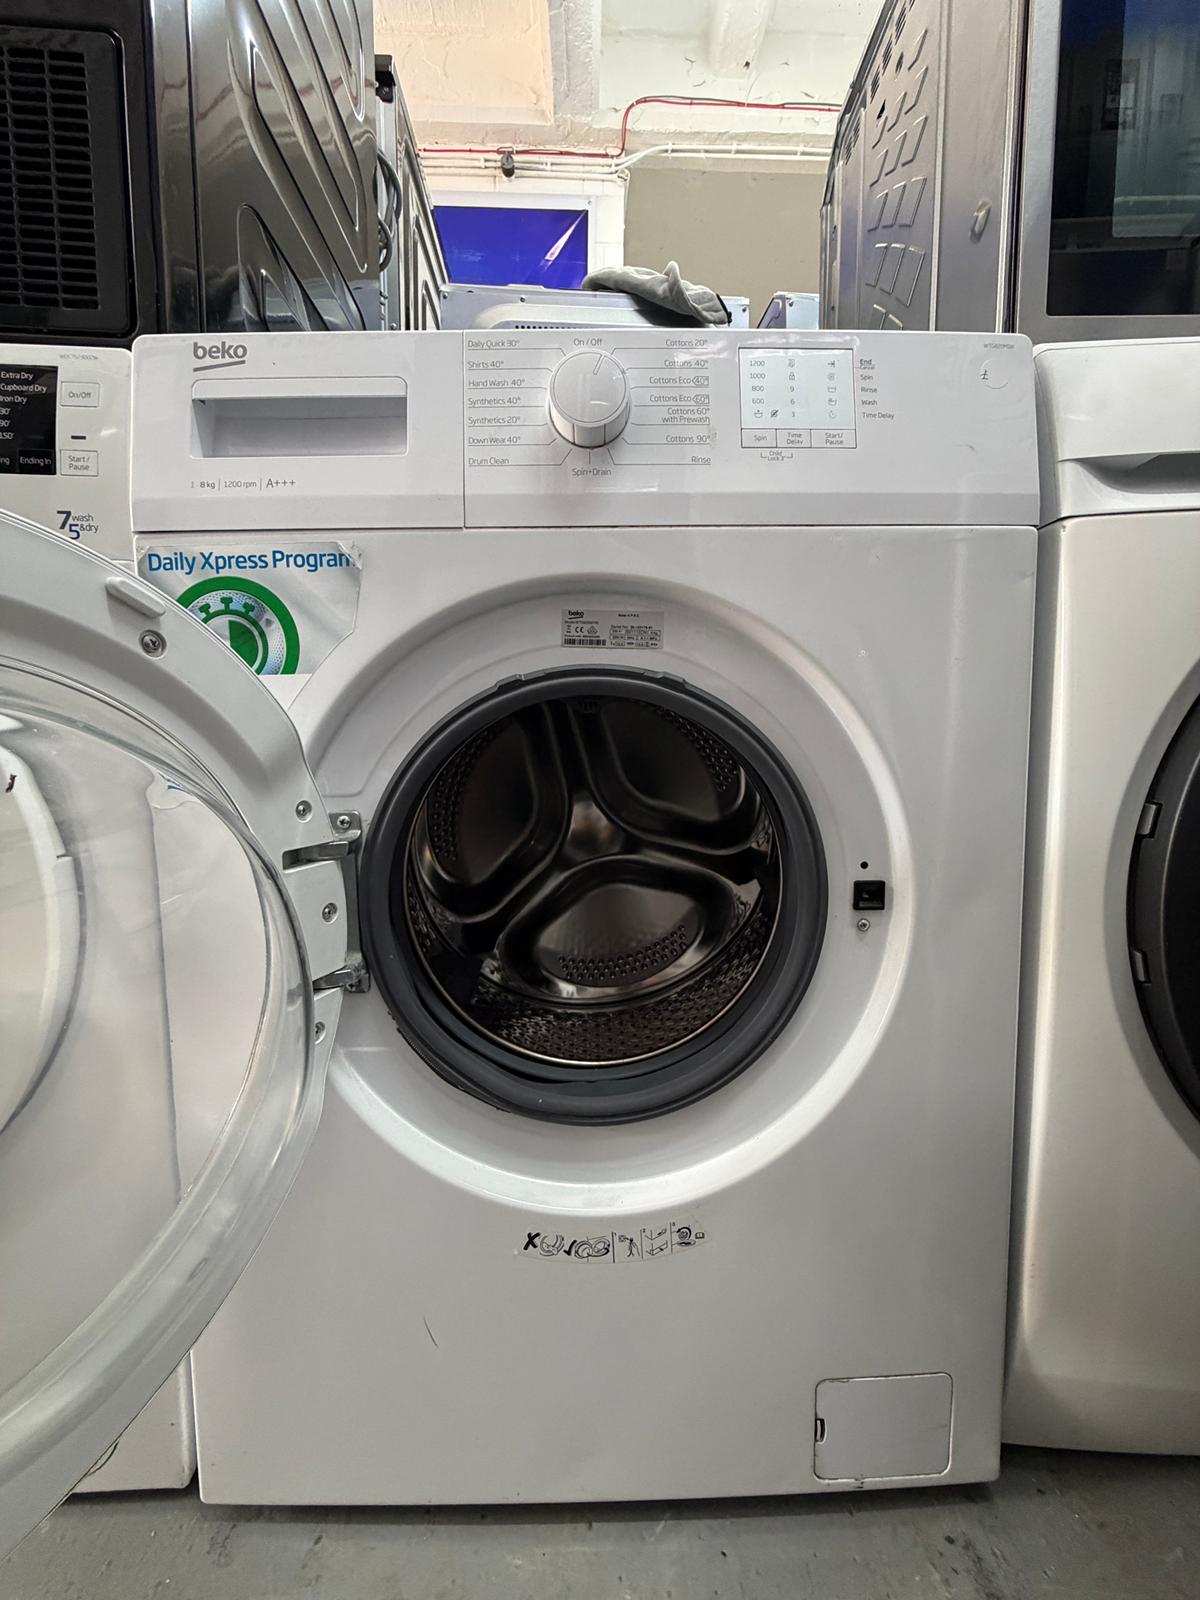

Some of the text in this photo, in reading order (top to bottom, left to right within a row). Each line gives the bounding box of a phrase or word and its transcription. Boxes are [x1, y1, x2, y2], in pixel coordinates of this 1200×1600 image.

[467, 339, 485, 348] Daily
[486, 339, 505, 349] Quick
[665, 339, 708, 347] Cottons 20°
[193, 341, 247, 359] beko
[467, 360, 504, 368] Shirts 40°
[0, 371, 34, 381] Extra Dry
[649, 376, 678, 384] Cottons
[679, 376, 691, 384] Eco
[469, 379, 525, 387] Hand Wash 40°
[0, 383, 48, 393] Cupboard Dry
[14, 395, 28, 405] Dry
[468, 396, 521, 407] Synthetics 40°
[649, 394, 678, 402] Cottons
[679, 394, 692, 402] Eco
[667, 407, 696, 415] Cottons
[878, 411, 895, 420] Delay
[468, 415, 521, 426] Synthetics 20°
[679, 415, 710, 423] Prewash
[468, 437, 489, 445] Down
[507, 436, 521, 444] 40°
[665, 435, 695, 443] Cottons
[753, 434, 768, 443] Spin
[786, 438, 804, 446] Delay
[20, 456, 44, 467] Ending
[44, 457, 52, 465] In
[468, 456, 510, 466] Drum Clean
[691, 455, 712, 463] Rinse
[68, 463, 90, 471] Pause
[223, 480, 242, 488] 1200
[242, 481, 257, 489] rpm
[266, 478, 297, 489] A+++
[56, 510, 94, 530] 7 wash
[69, 523, 80, 540] 5
[147, 552, 196, 575] Daily
[199, 551, 269, 575] Xpress
